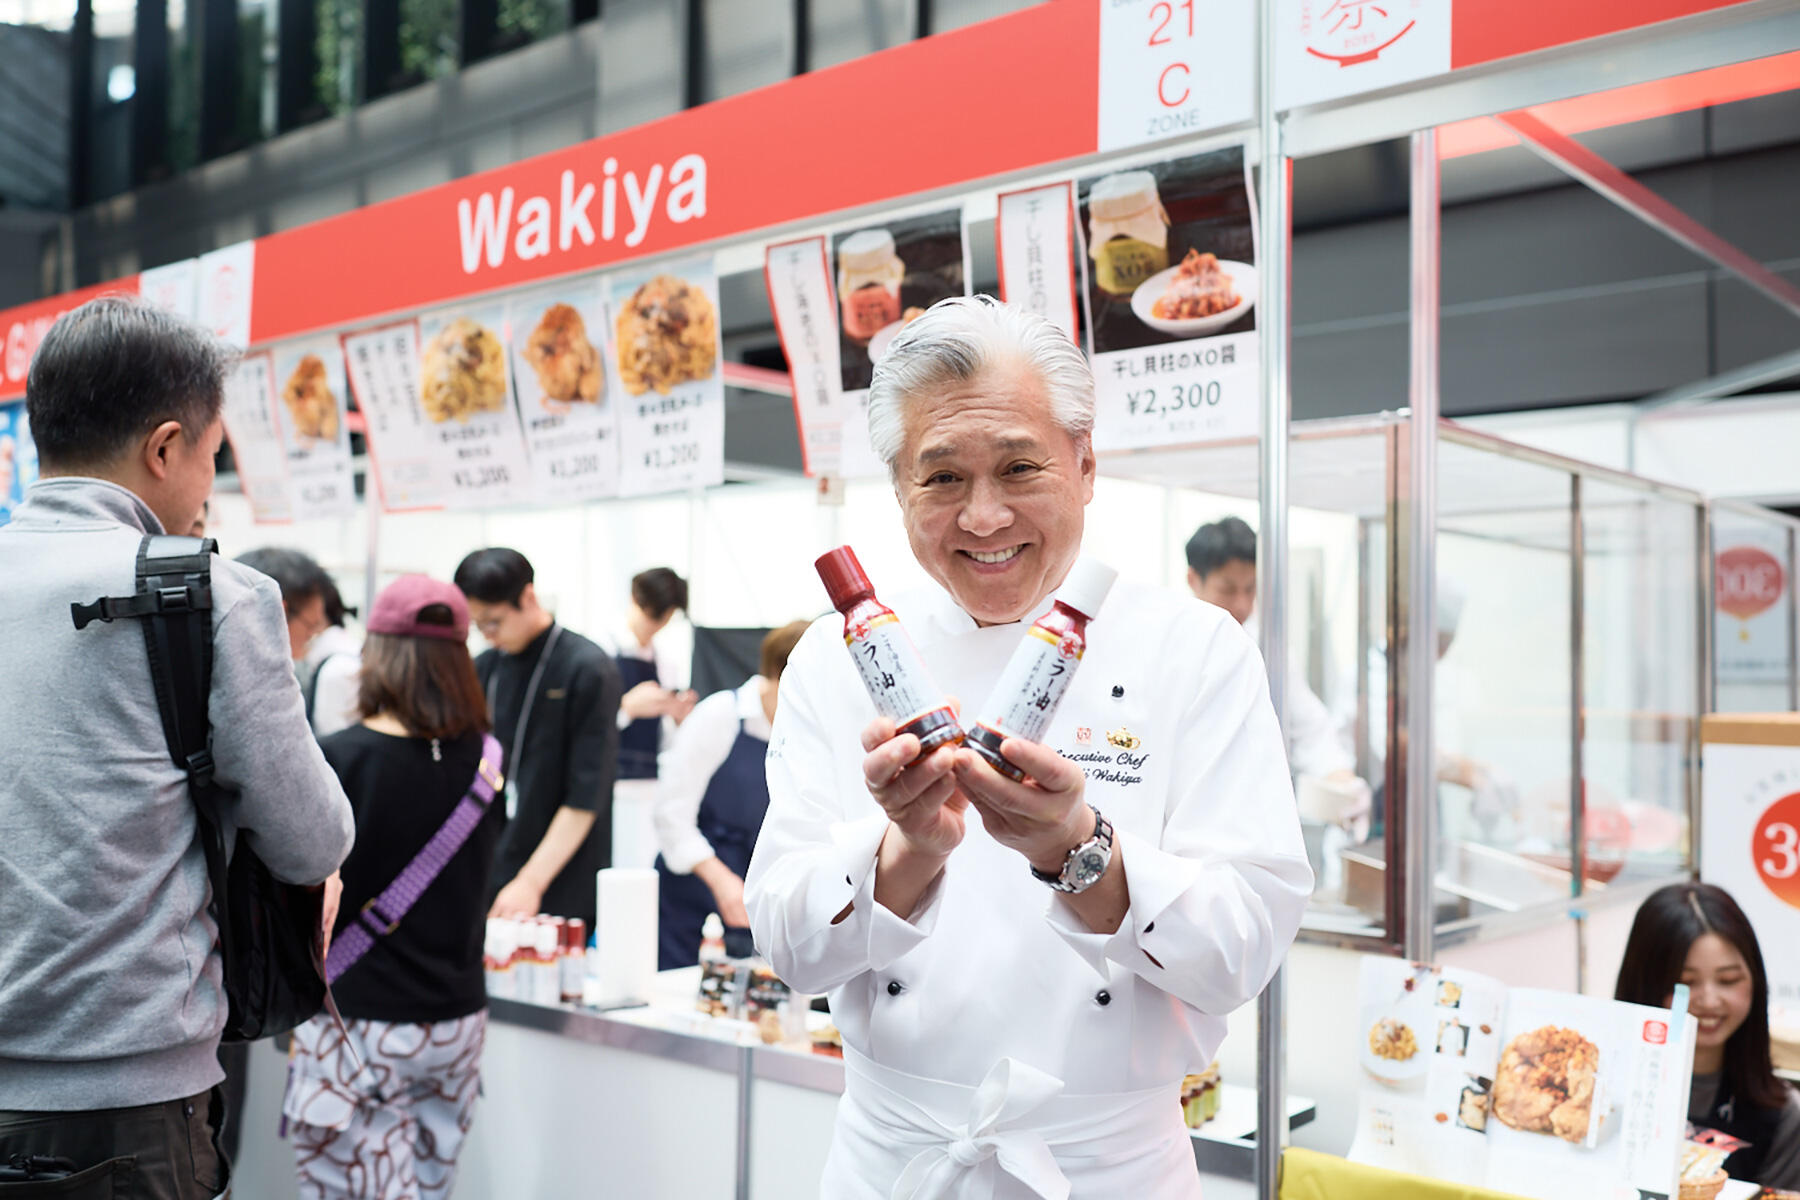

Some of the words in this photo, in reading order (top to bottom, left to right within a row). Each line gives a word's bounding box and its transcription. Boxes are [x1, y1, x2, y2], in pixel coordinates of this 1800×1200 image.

[1148, 0, 1194, 46] 21
[1158, 62, 1190, 107] C
[1147, 108, 1200, 135] ZONE
[457, 153, 707, 274] Wakiya
[1113, 344, 1236, 380] 干し貝柱のXO醤
[1127, 381, 1221, 418] ¥2,300
[862, 641, 896, 696] ラー油
[1026, 658, 1066, 711] ラー油
[1092, 768, 1143, 787] Wakiya
[1116, 752, 1150, 770] Chef
